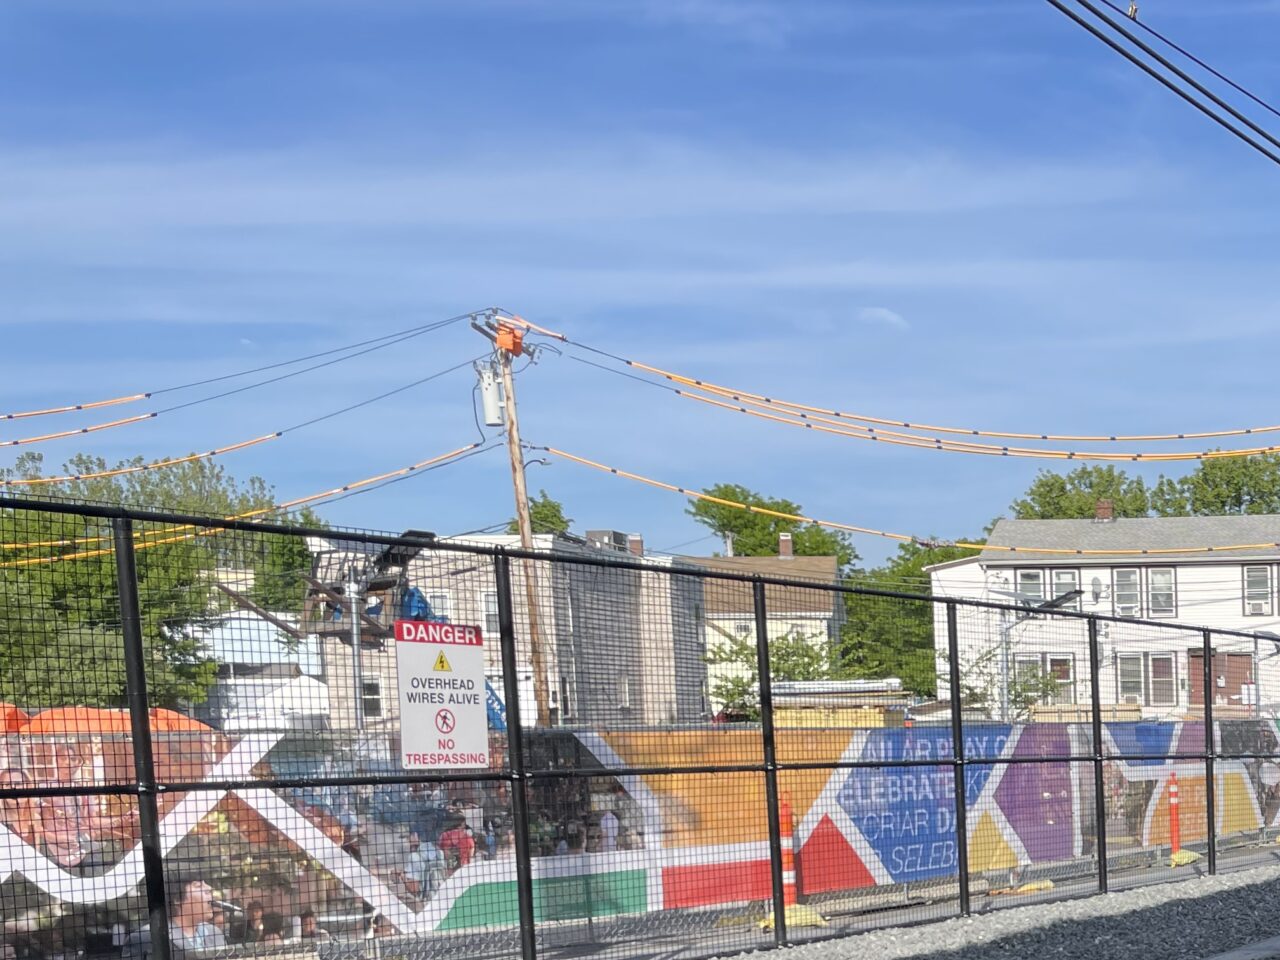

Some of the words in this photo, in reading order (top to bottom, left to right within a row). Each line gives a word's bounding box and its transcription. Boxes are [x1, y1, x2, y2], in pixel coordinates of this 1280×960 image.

[402, 623, 477, 644] DANGER
[411, 677, 474, 690] OVERHEAD
[406, 692, 445, 704] WIRES
[448, 693, 480, 704] ALIVE
[438, 739, 455, 750] NO
[406, 753, 486, 765] TRESPASSING
[890, 841, 958, 875] SELEB
